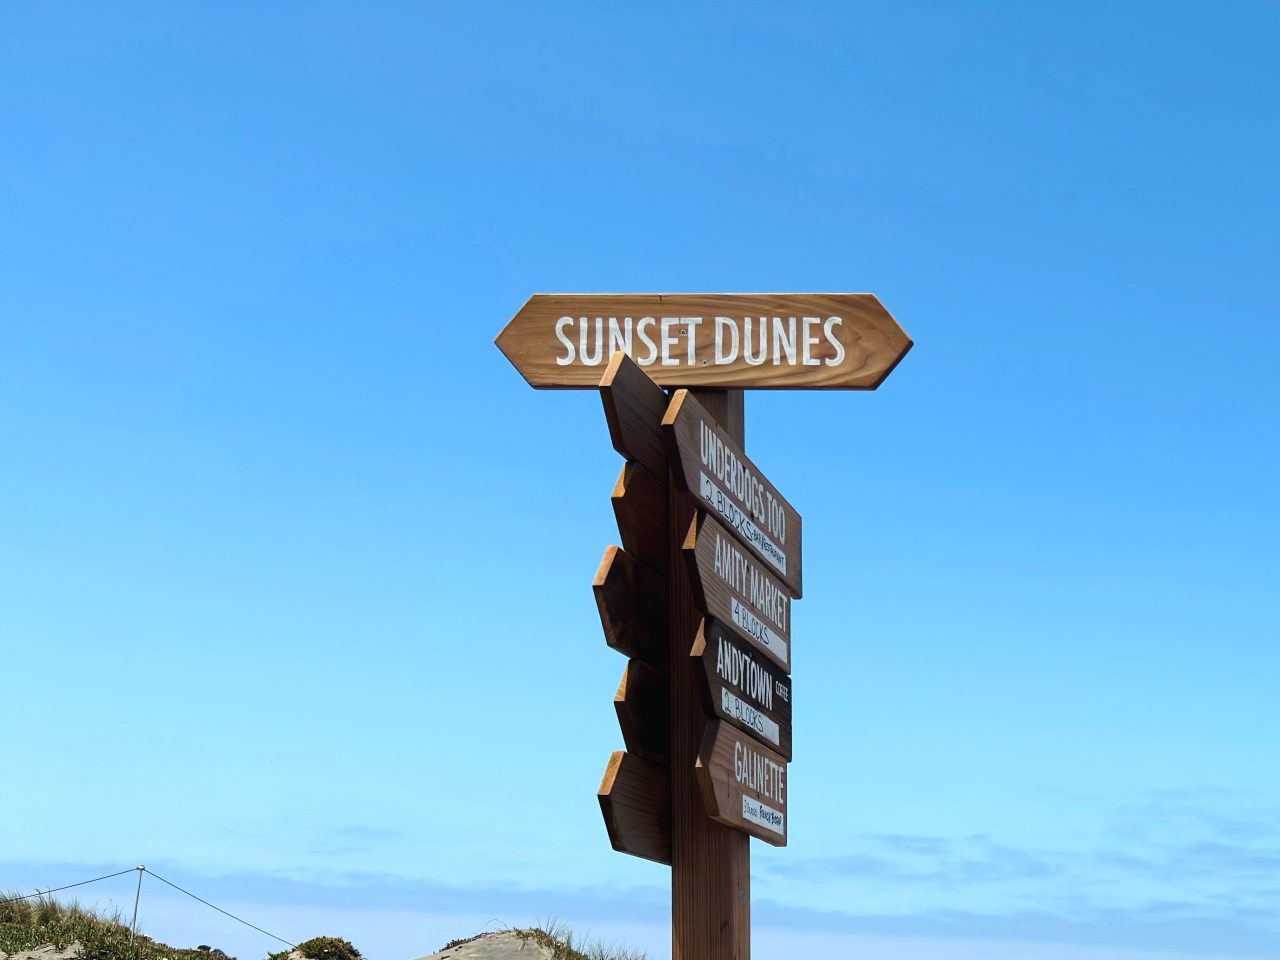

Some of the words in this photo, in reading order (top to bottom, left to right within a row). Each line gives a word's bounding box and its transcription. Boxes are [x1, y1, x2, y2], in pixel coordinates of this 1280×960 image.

[555, 316, 702, 367] SUNSET
[714, 316, 846, 367] DUNES
[700, 419, 765, 525] UNDERDOGS
[766, 493, 785, 546] TOO
[704, 479, 714, 505] 2
[716, 492, 752, 541] BLOCKS
[714, 534, 748, 598] AMITY
[750, 565, 788, 633] MARKET
[734, 603, 740, 624] 4
[742, 609, 769, 645] BLOCKS
[716, 636, 773, 711] ANDYTOWN
[723, 698, 732, 714] 2
[735, 698, 764, 733] BLOCKS
[734, 740, 784, 805] GALINETTE
